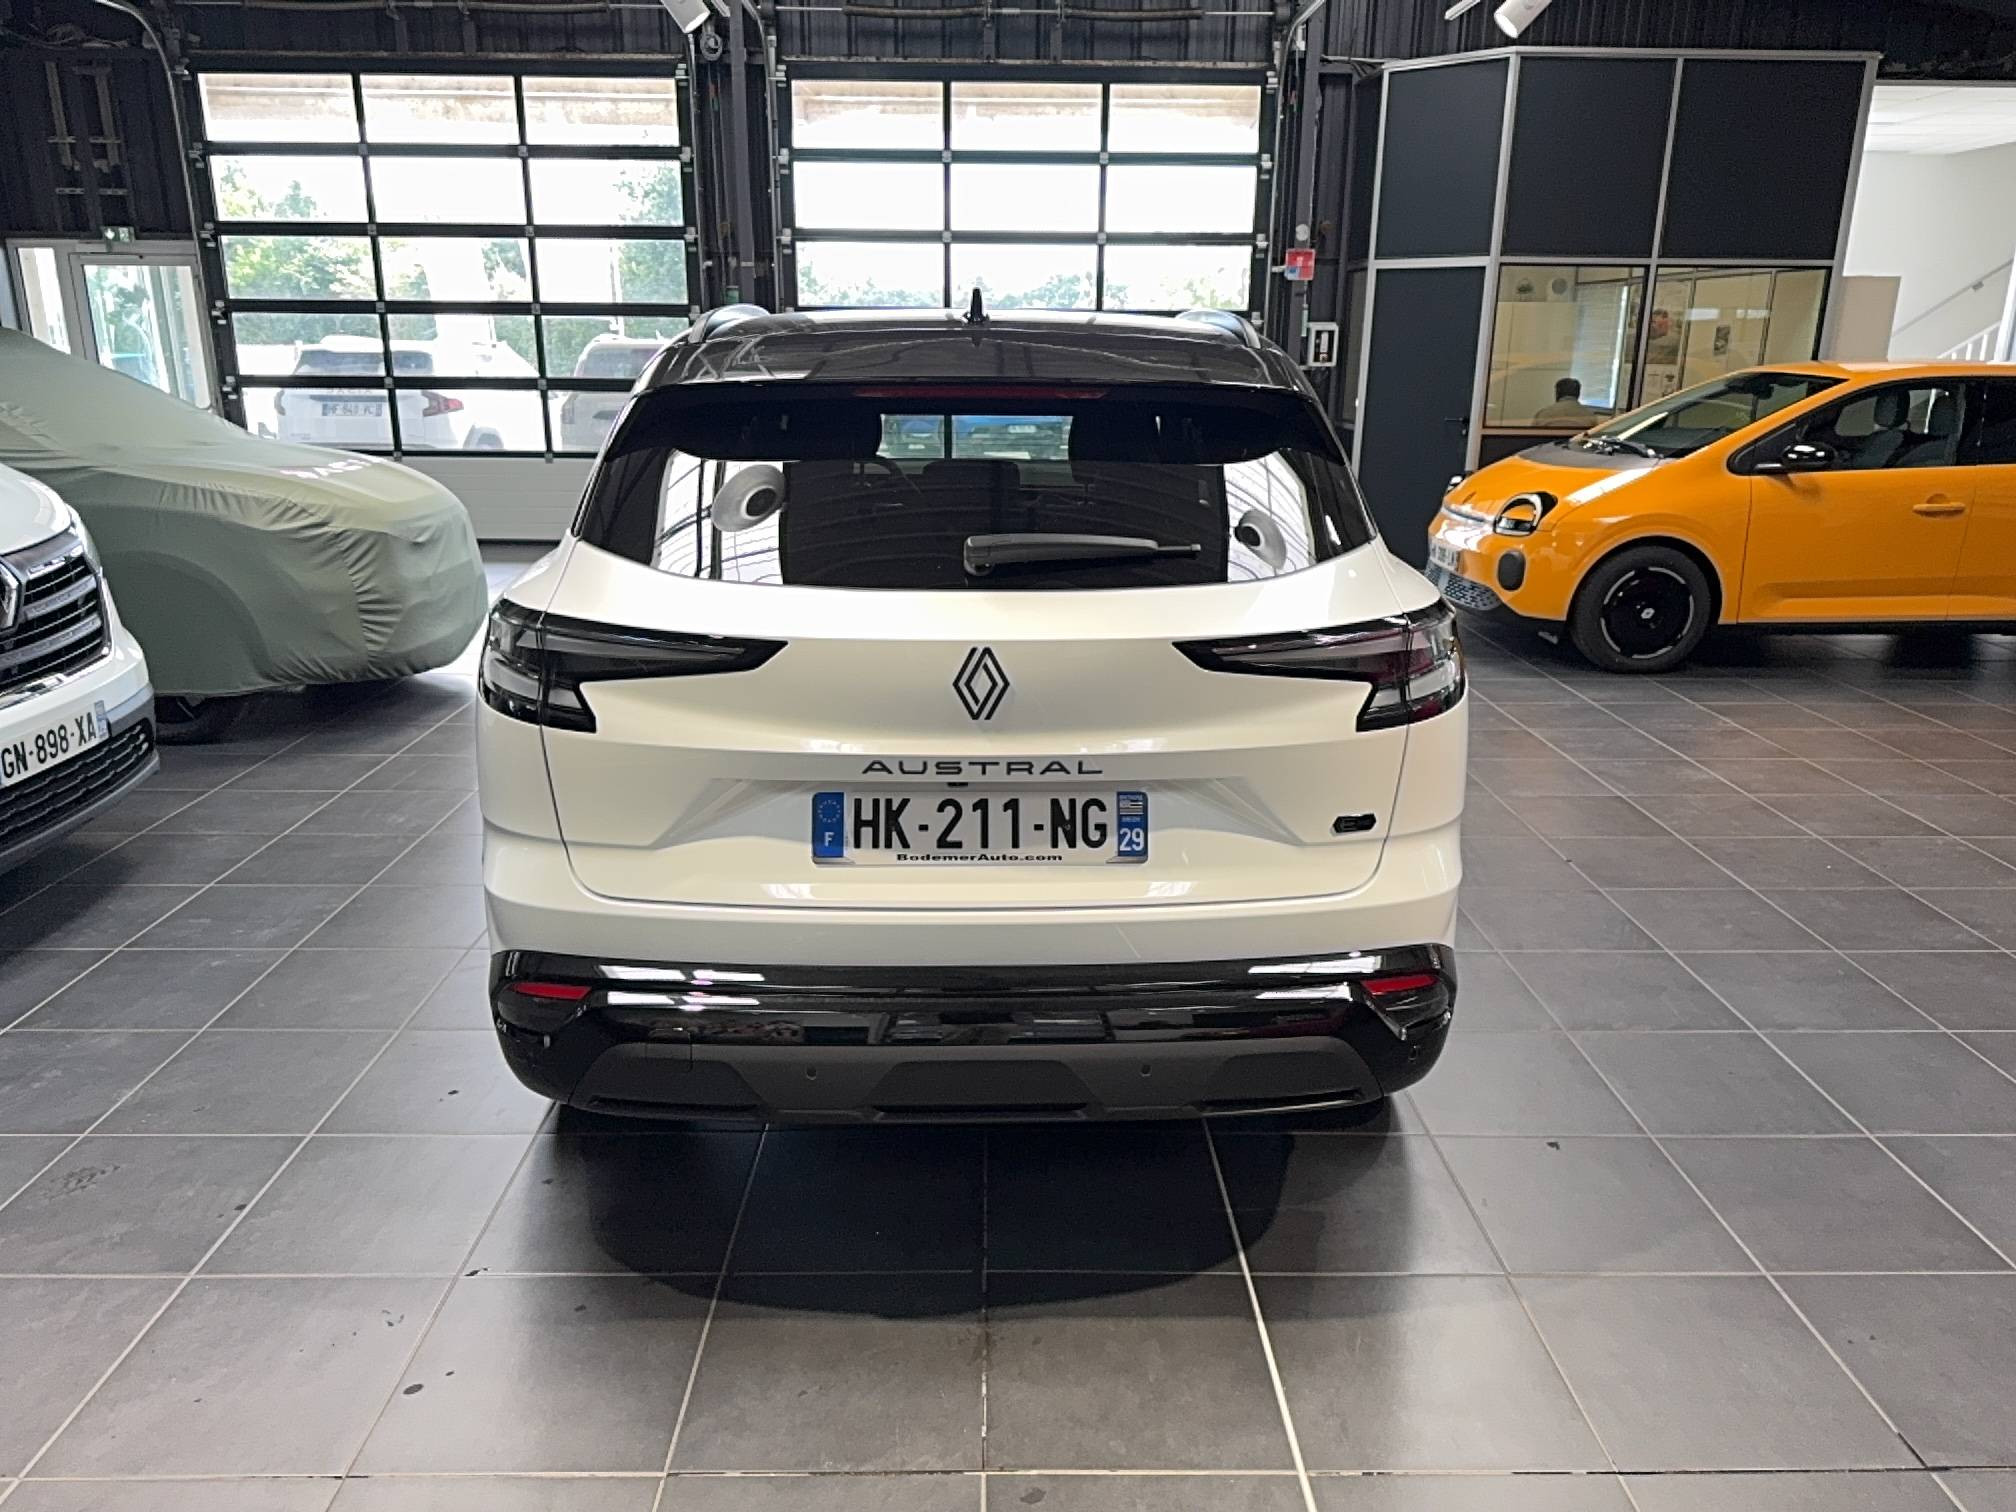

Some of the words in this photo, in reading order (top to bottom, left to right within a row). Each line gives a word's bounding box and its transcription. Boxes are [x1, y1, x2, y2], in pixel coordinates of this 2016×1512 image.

[1, 712, 97, 778] GN-898-XA
[861, 760, 1103, 775] AUSTRAL
[852, 797, 1108, 849] HK-211-NG
[824, 831, 835, 847] F
[1119, 827, 1144, 851] 29
